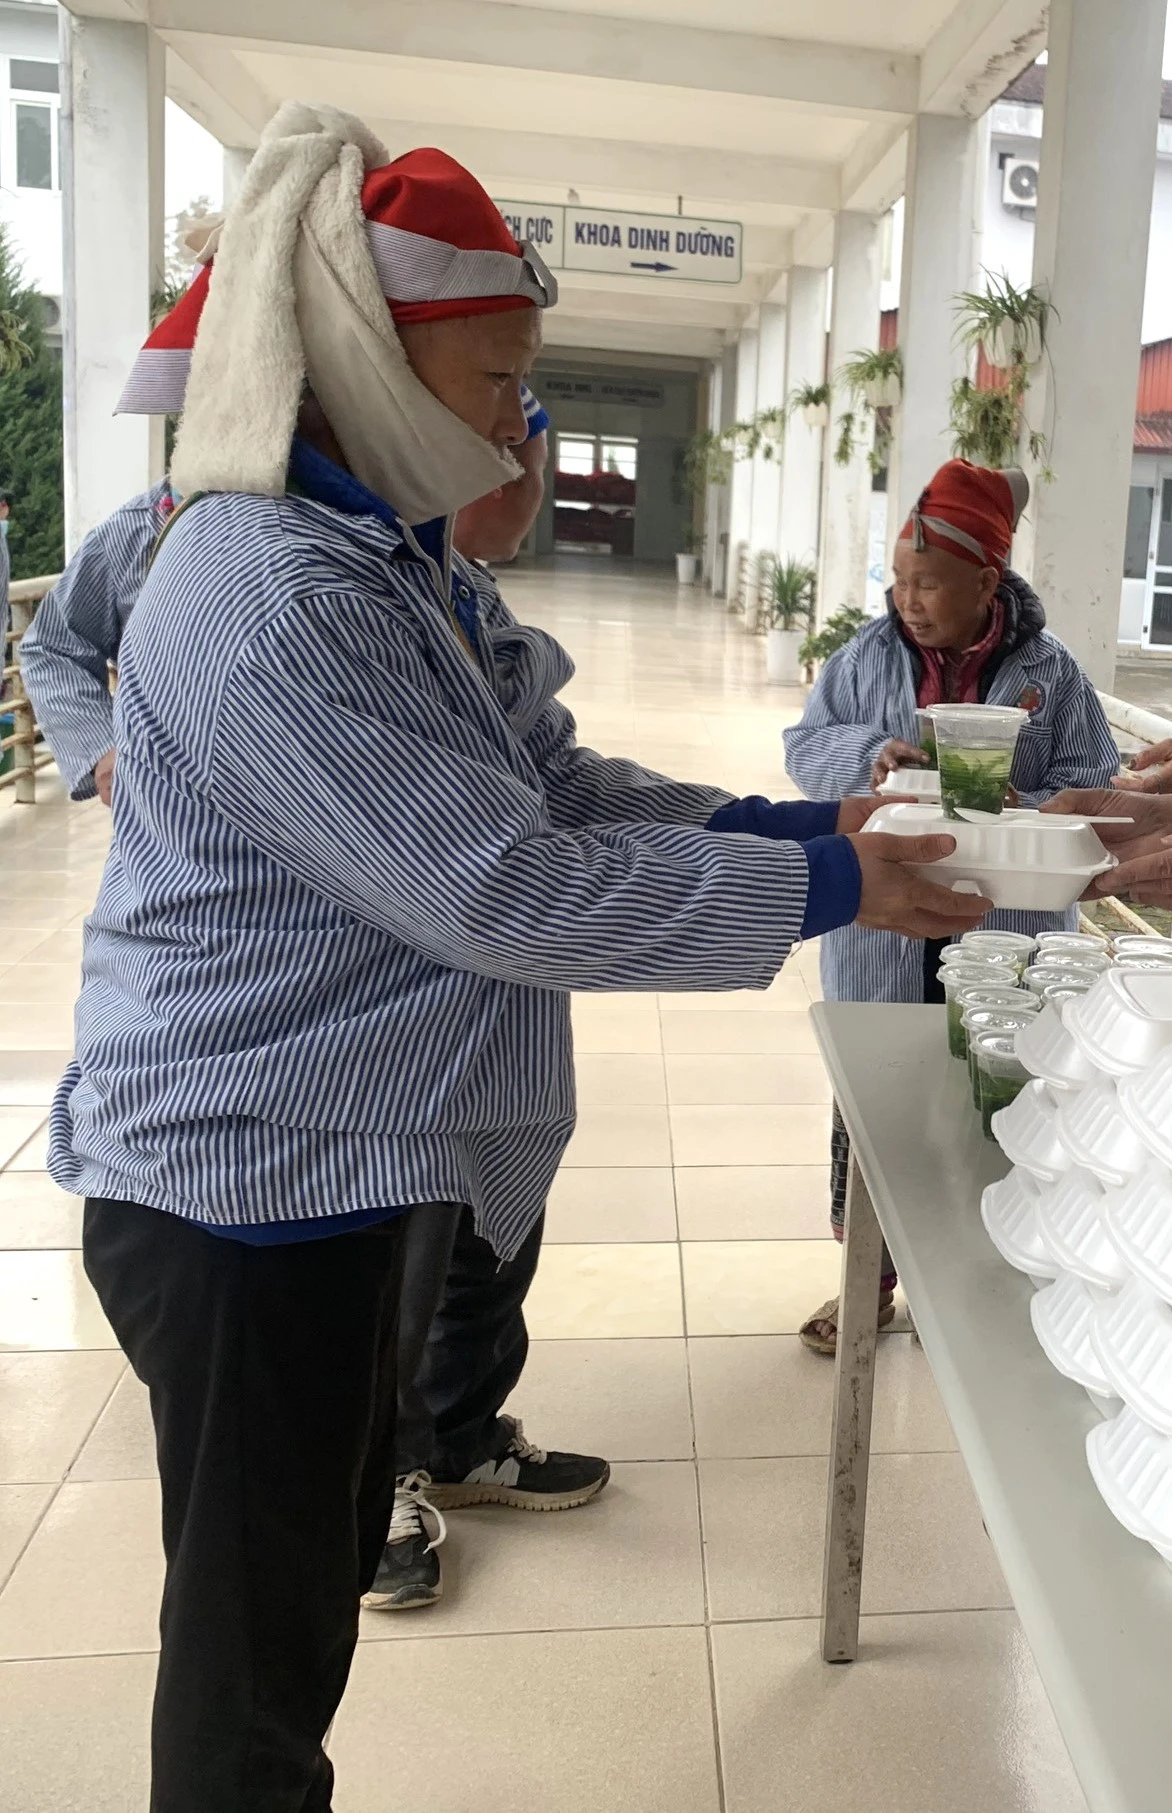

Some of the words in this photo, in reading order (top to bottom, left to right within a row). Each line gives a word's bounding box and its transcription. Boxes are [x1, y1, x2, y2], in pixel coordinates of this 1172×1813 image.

[574, 221, 622, 248] KHOA
[628, 226, 670, 253] DINH
[675, 226, 735, 258] DƯỠNG
